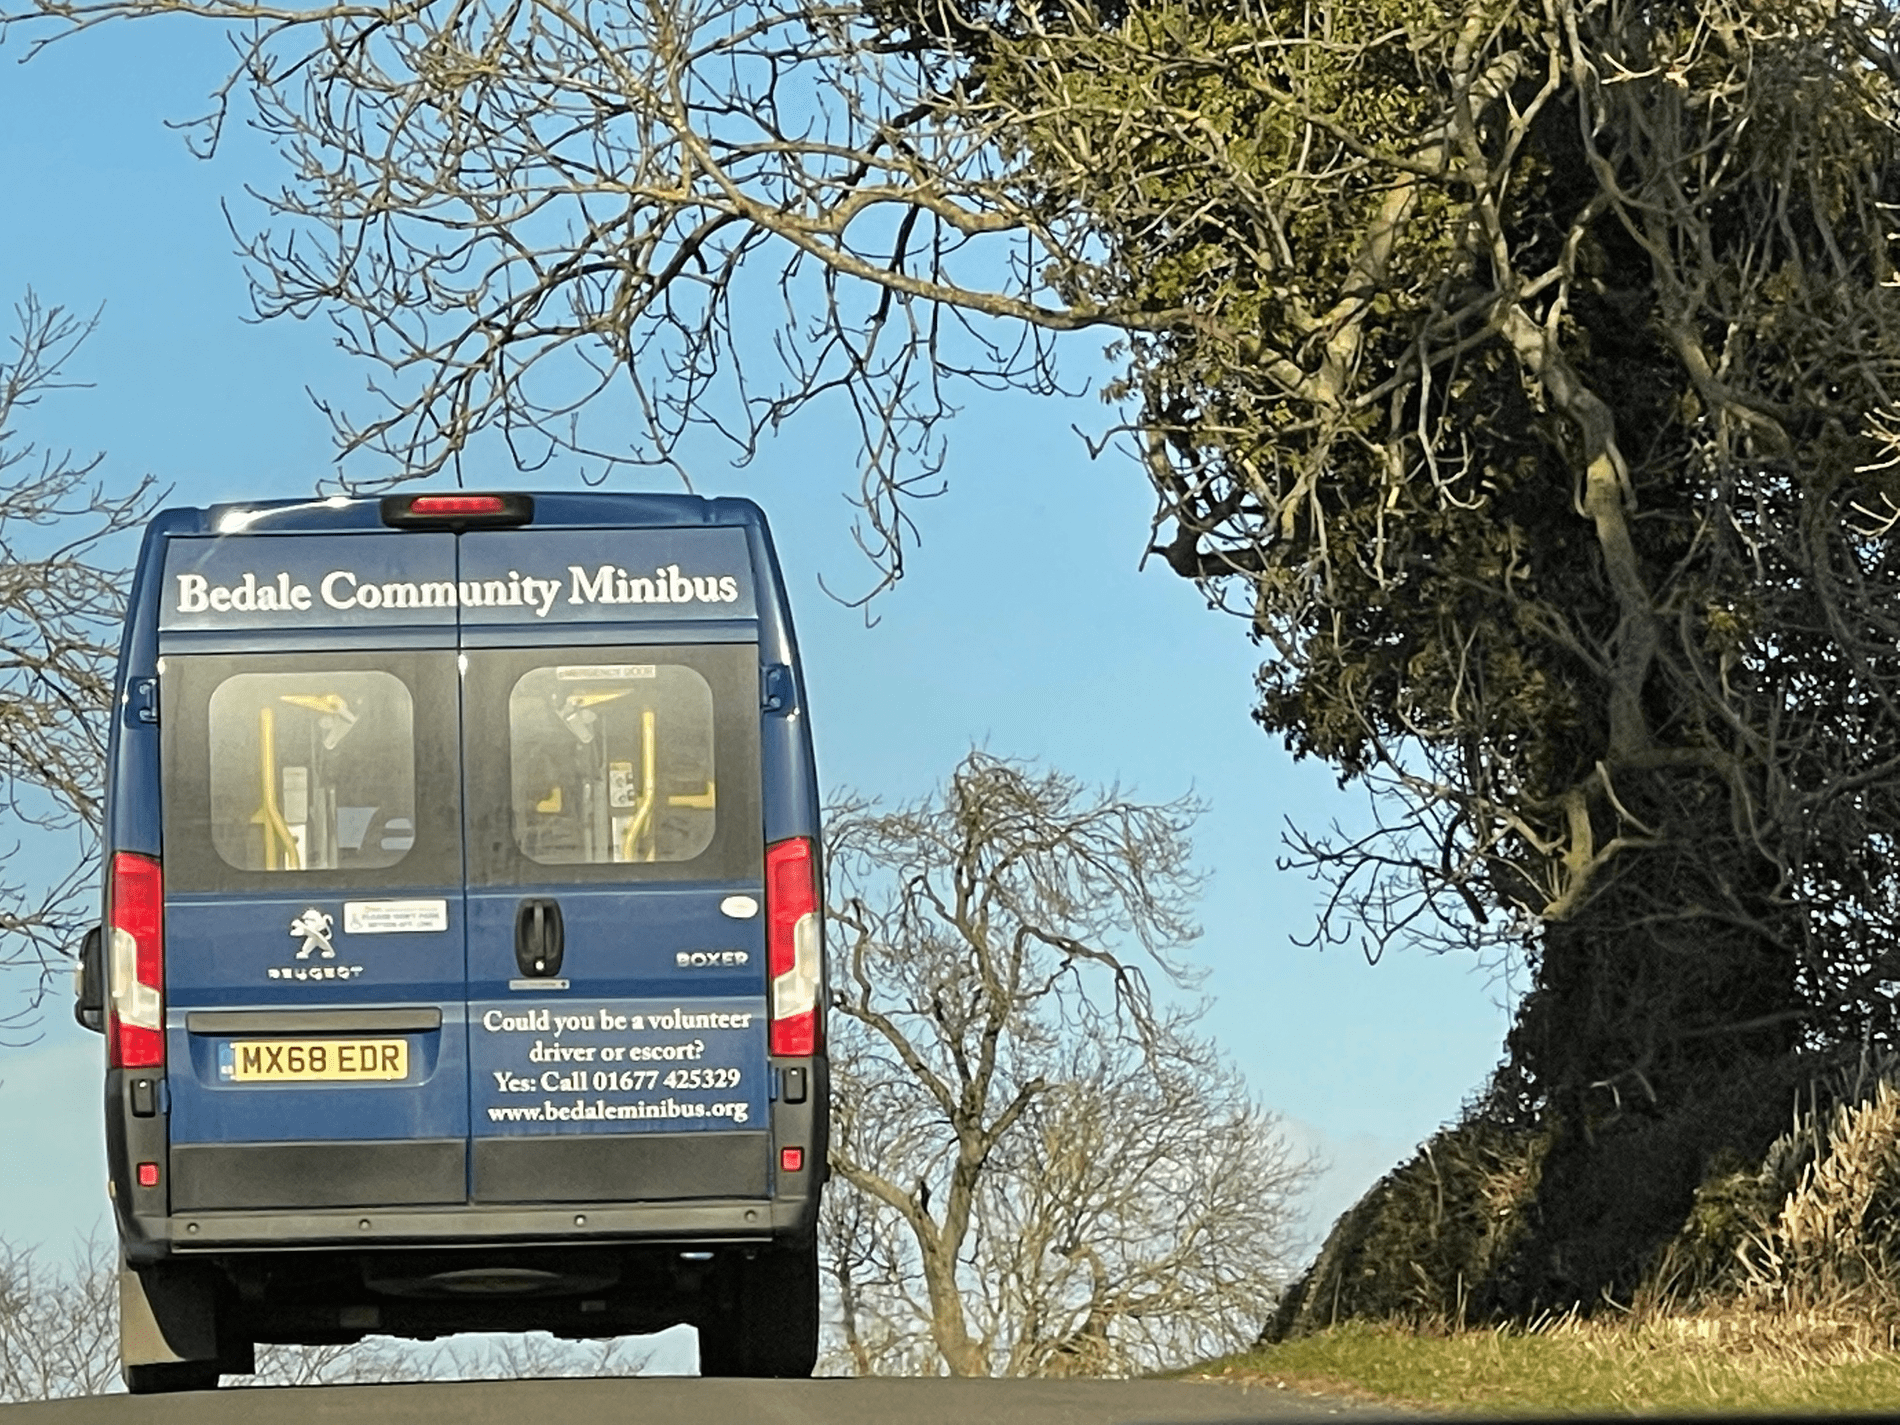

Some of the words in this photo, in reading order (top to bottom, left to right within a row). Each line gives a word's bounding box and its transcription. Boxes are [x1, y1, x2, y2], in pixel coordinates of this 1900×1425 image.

[177, 572, 312, 612] Bedale
[320, 571, 562, 617] Community
[568, 564, 738, 605] Minibus
[676, 951, 749, 968] BOXER
[483, 1009, 550, 1031] Could
[553, 1015, 595, 1038] you
[599, 1009, 627, 1031] be
[631, 1016, 645, 1030] a
[648, 1008, 752, 1030] volunteer
[243, 1046, 327, 1074] MX68
[338, 1045, 400, 1072] EDR
[529, 1040, 597, 1062] driver
[600, 1045, 626, 1062] or
[629, 1039, 706, 1061] escort?
[493, 1071, 537, 1092] Yes:
[540, 1070, 588, 1092] Call
[592, 1070, 660, 1091] 01677
[662, 1068, 741, 1090] 425329
[487, 1098, 749, 1123] www.bedaleminibus.org
